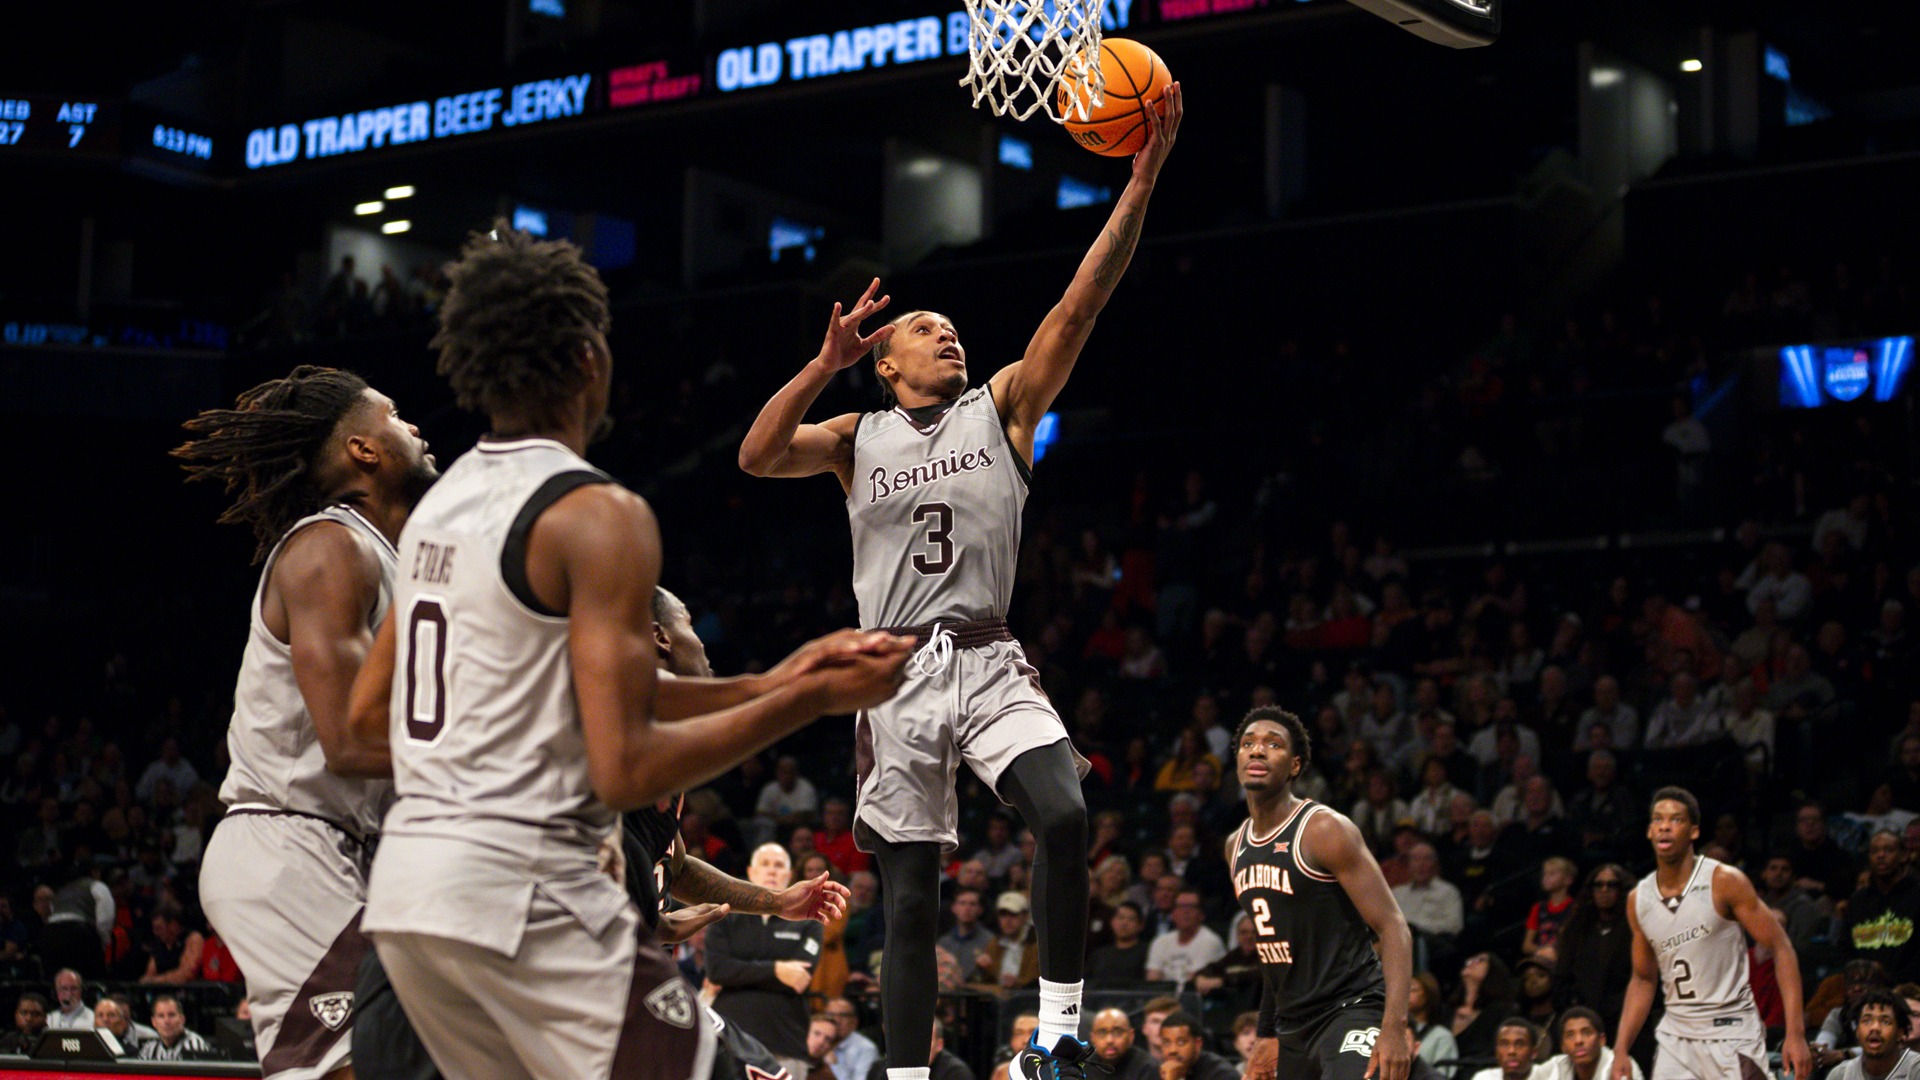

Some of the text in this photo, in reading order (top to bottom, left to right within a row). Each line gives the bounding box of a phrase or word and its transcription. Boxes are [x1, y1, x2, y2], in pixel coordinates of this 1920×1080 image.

[717, 41, 783, 92] OLD
[785, 15, 942, 80] TRAPPER
[0, 99, 30, 120] EB
[56, 102, 98, 123] AST
[246, 73, 591, 169] OLD TRAPPER BEEF JERKY
[68, 124, 85, 148] 7
[868, 446, 996, 504] Bonnies
[911, 500, 955, 577] 3
[411, 540, 456, 584] EVANS
[401, 593, 453, 748] 0
[1234, 863, 1294, 900] KLAHOMA
[1251, 898, 1275, 936] 2
[1256, 942, 1293, 964] STATE
[1649, 923, 1712, 957] onnies
[1673, 958, 1697, 1000] 2
[61, 1038, 81, 1053] POSS
